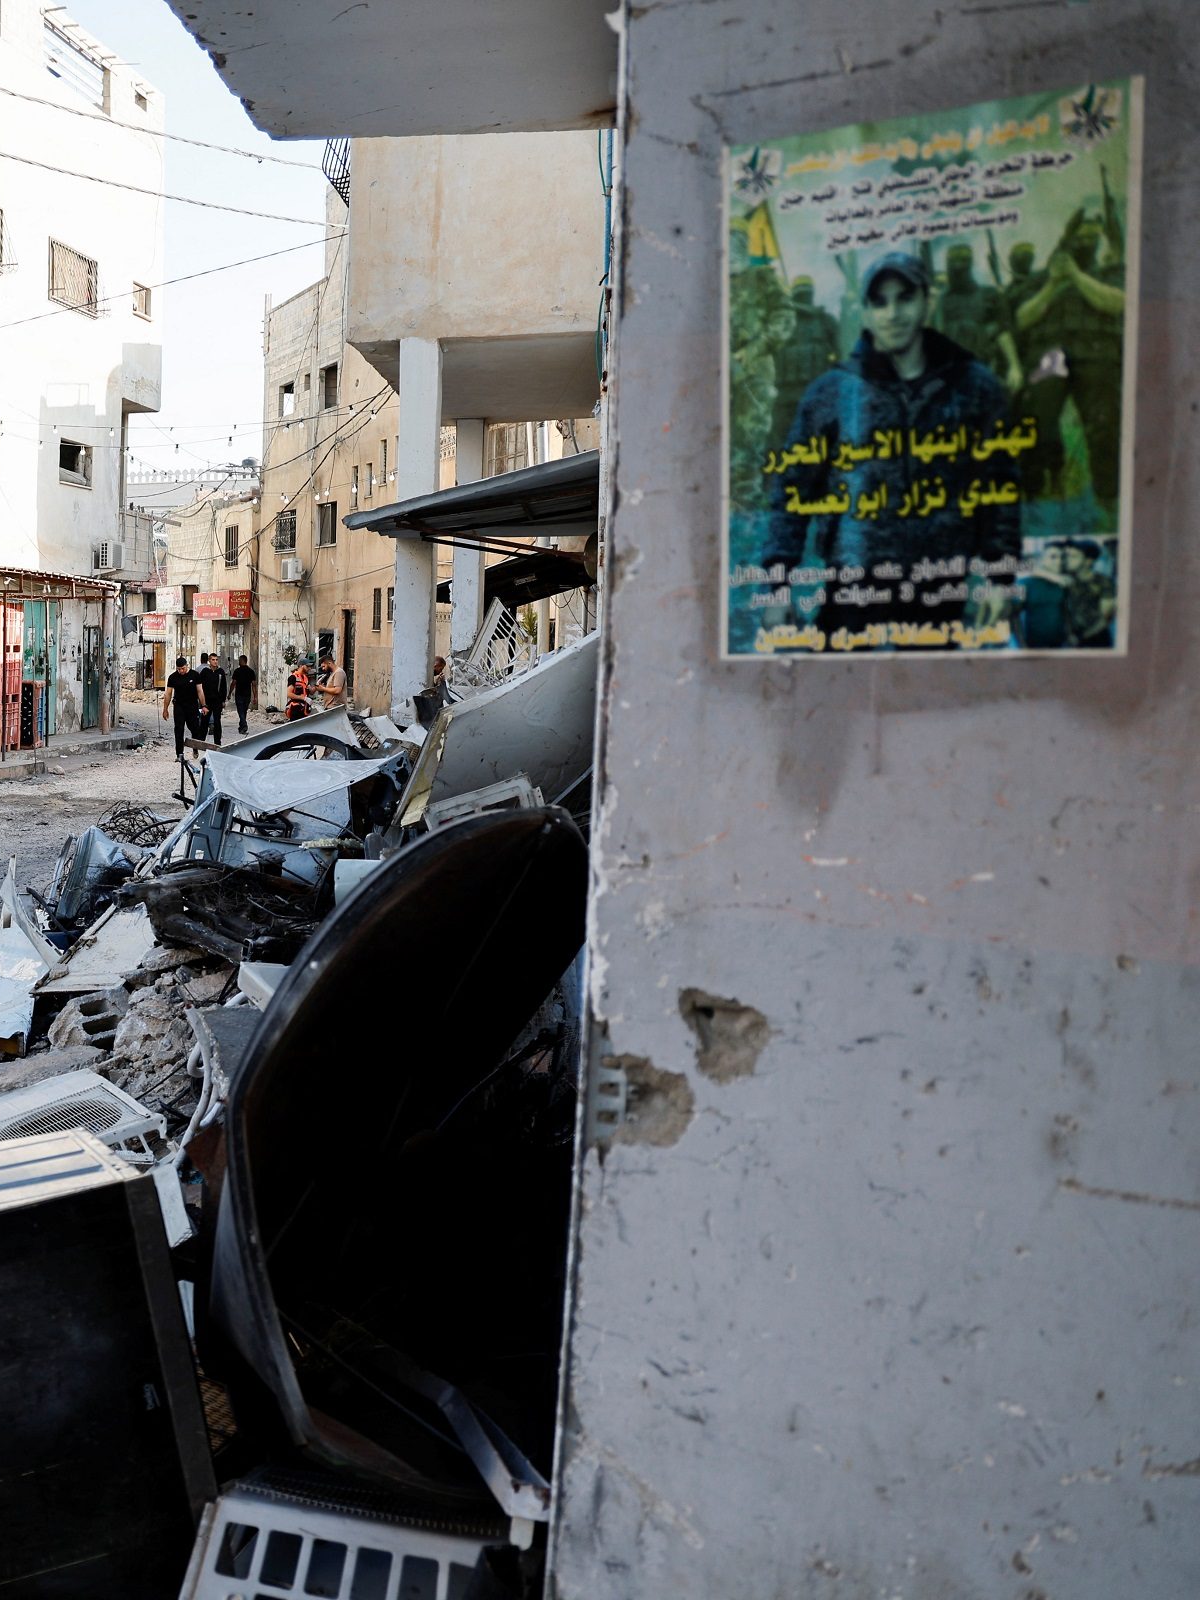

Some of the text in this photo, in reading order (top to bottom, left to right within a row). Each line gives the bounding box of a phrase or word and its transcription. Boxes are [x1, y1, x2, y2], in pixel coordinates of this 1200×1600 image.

[762, 436, 828, 475] المحرر
[831, 429, 903, 470] الاسير
[855, 481, 888, 520] ابو
[896, 476, 948, 517] نزار
[957, 478, 1020, 518] عدي
